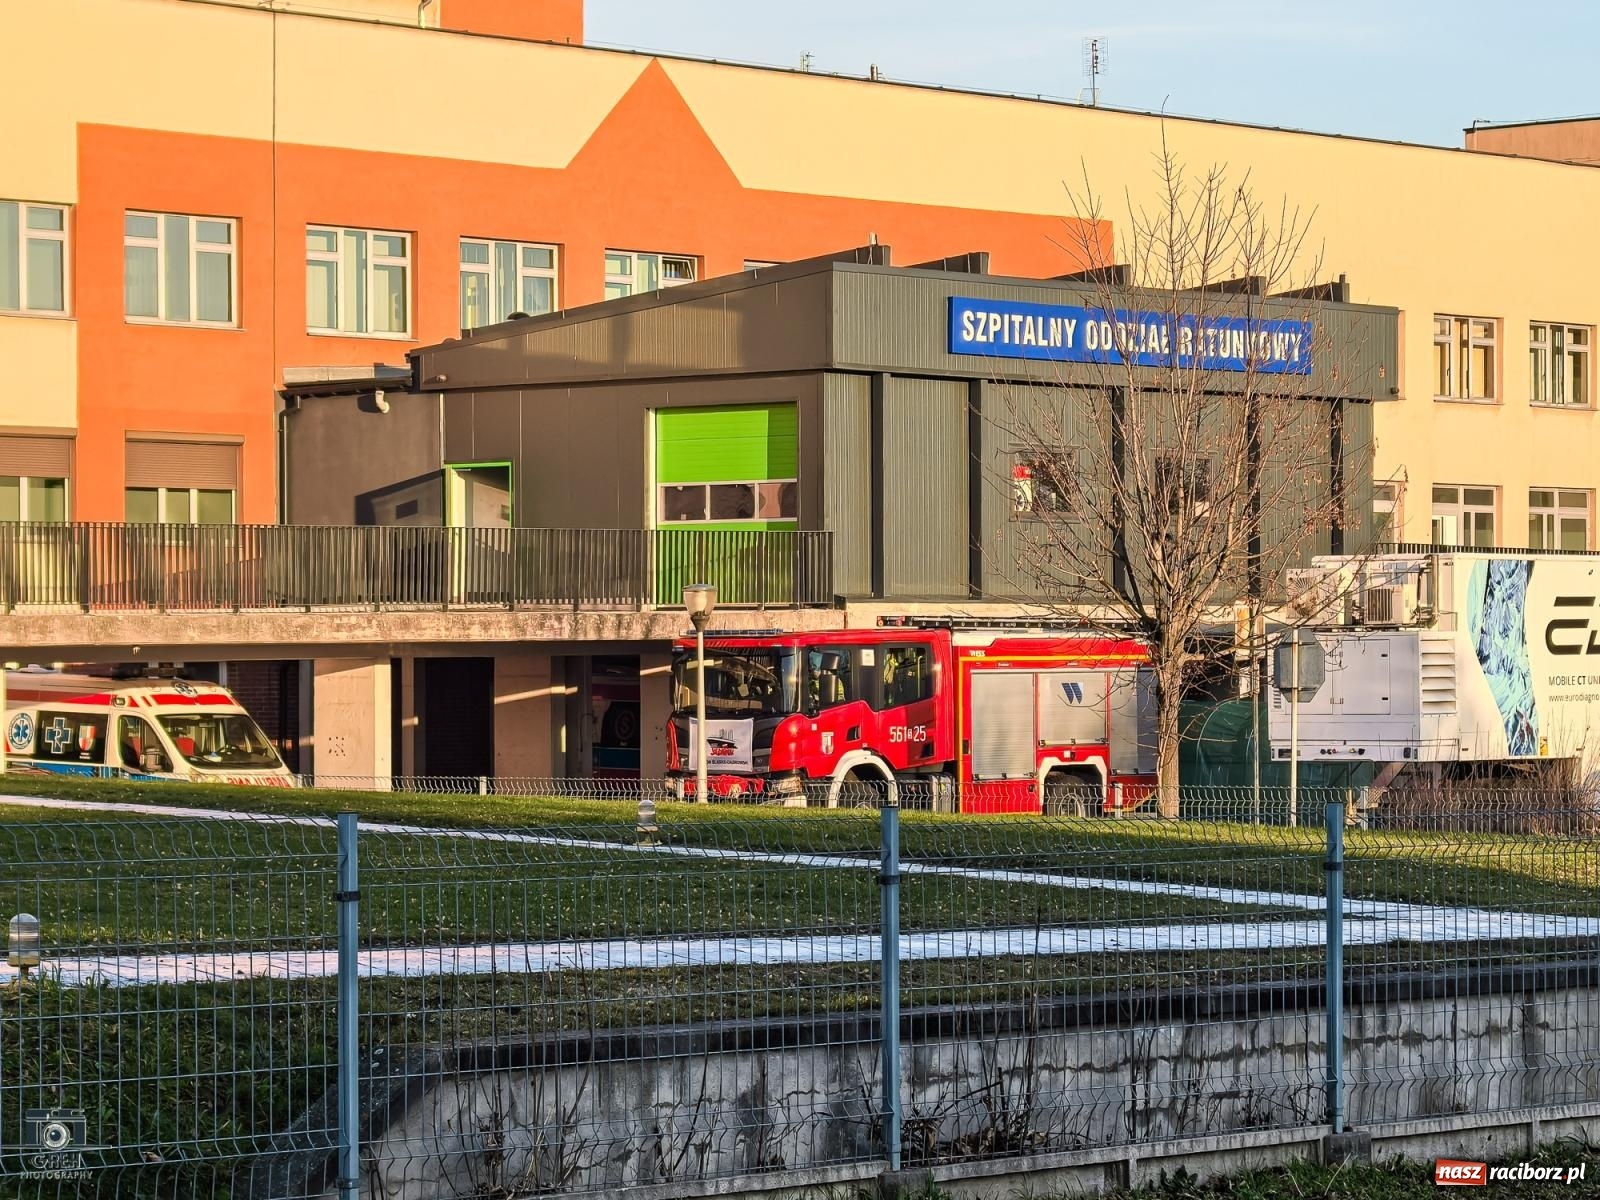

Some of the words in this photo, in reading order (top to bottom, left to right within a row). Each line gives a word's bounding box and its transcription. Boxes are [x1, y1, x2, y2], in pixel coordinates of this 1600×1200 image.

[962, 310, 1077, 348] SZPITALNY
[1548, 675, 1576, 686] MOBILE
[1577, 675, 1587, 686] CT
